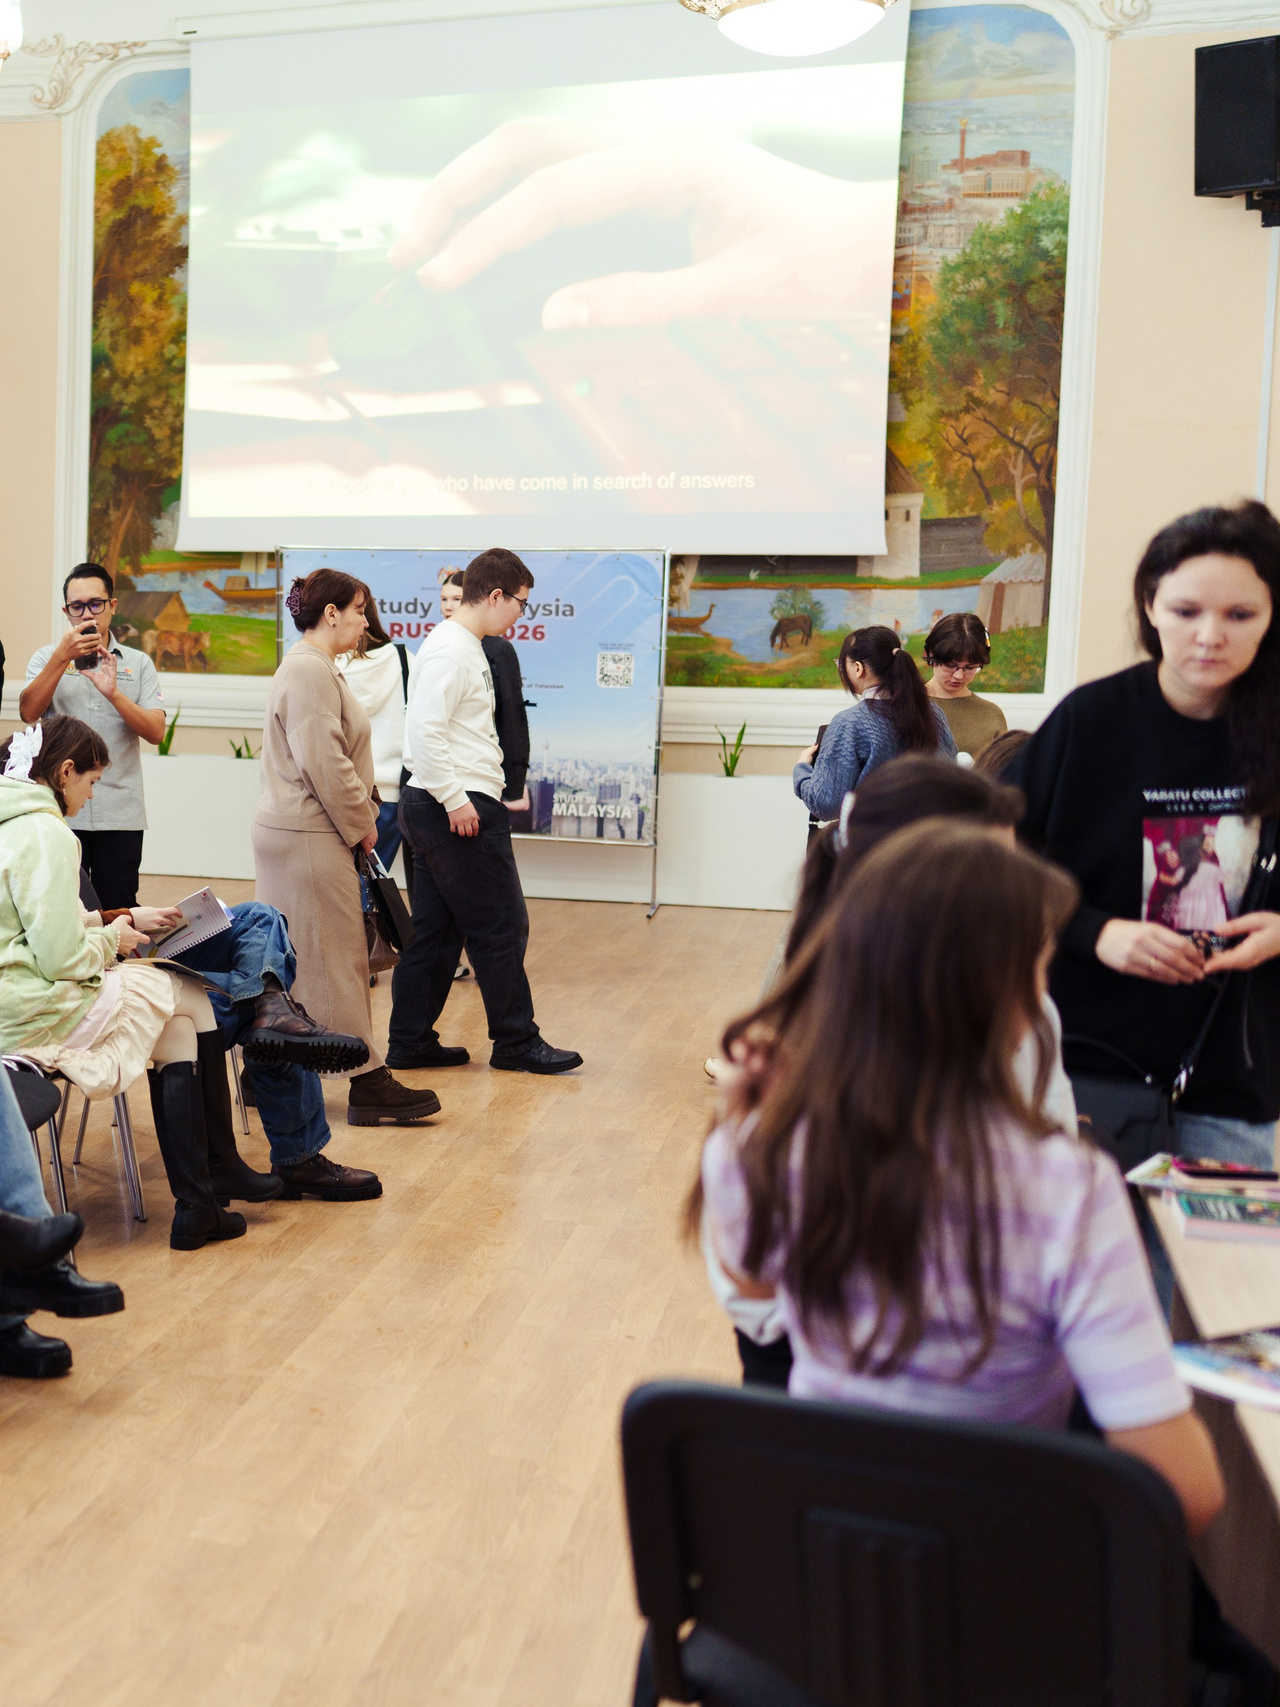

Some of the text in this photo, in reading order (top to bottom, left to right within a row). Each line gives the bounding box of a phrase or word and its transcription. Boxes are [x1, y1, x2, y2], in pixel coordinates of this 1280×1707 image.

[437, 475, 468, 491] who
[473, 474, 515, 491] have
[520, 476, 568, 491] come
[572, 473, 588, 490] in
[592, 472, 653, 490] search
[657, 472, 677, 489] of
[680, 473, 756, 489] answers
[377, 597, 575, 621] tudy ysia
[389, 622, 546, 641] RUS 026
[552, 791, 597, 805] STUDY IN
[551, 803, 632, 819] MALAYSIA
